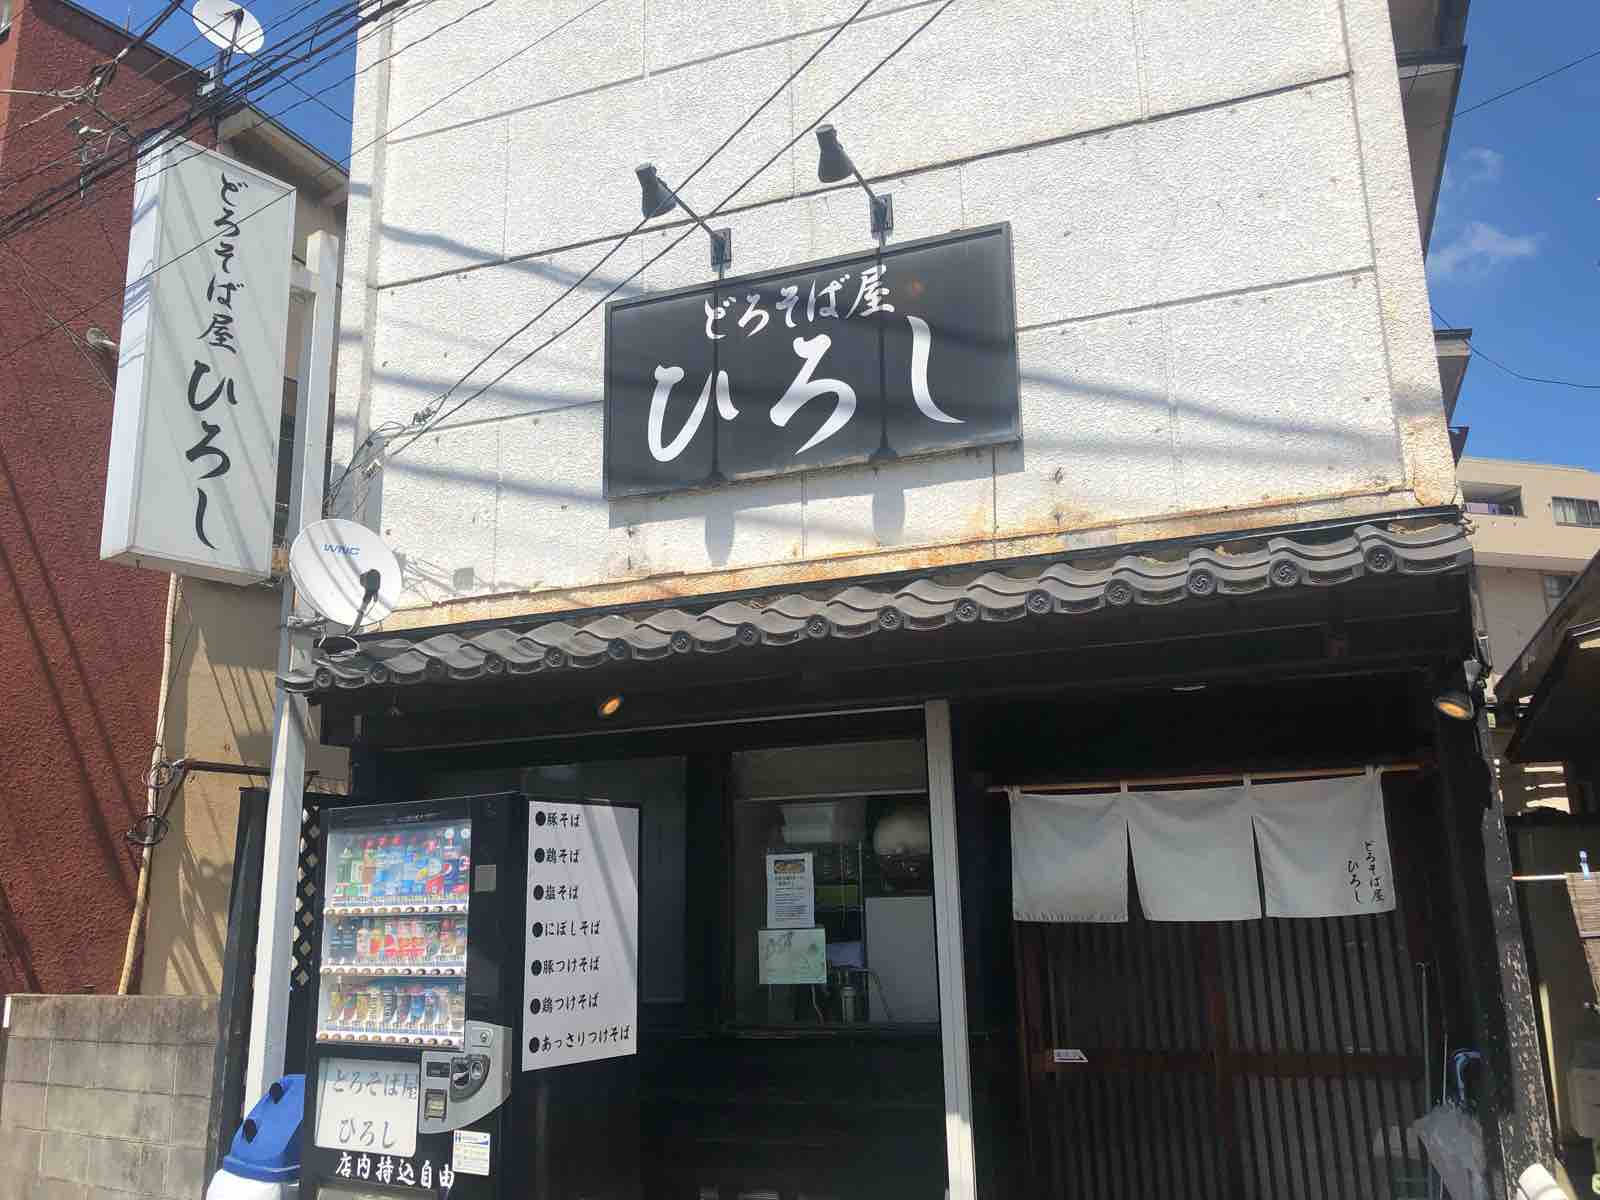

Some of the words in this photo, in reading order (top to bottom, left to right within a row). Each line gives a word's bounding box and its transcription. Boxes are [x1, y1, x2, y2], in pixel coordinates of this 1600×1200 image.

[197, 172, 249, 354] どろそば屋
[704, 264, 896, 339] どろそば屋
[647, 315, 966, 462] ひろし
[185, 360, 238, 550] ひろし
[323, 543, 361, 556] WNC
[546, 811, 581, 828] 豚そば
[1347, 859, 1363, 904] ひろし
[542, 955, 601, 975] 豚つけそば
[541, 1024, 631, 1052] あっさりつけそば
[338, 1119, 395, 1149] ひろし
[335, 1151, 455, 1190] 店内持込自由
